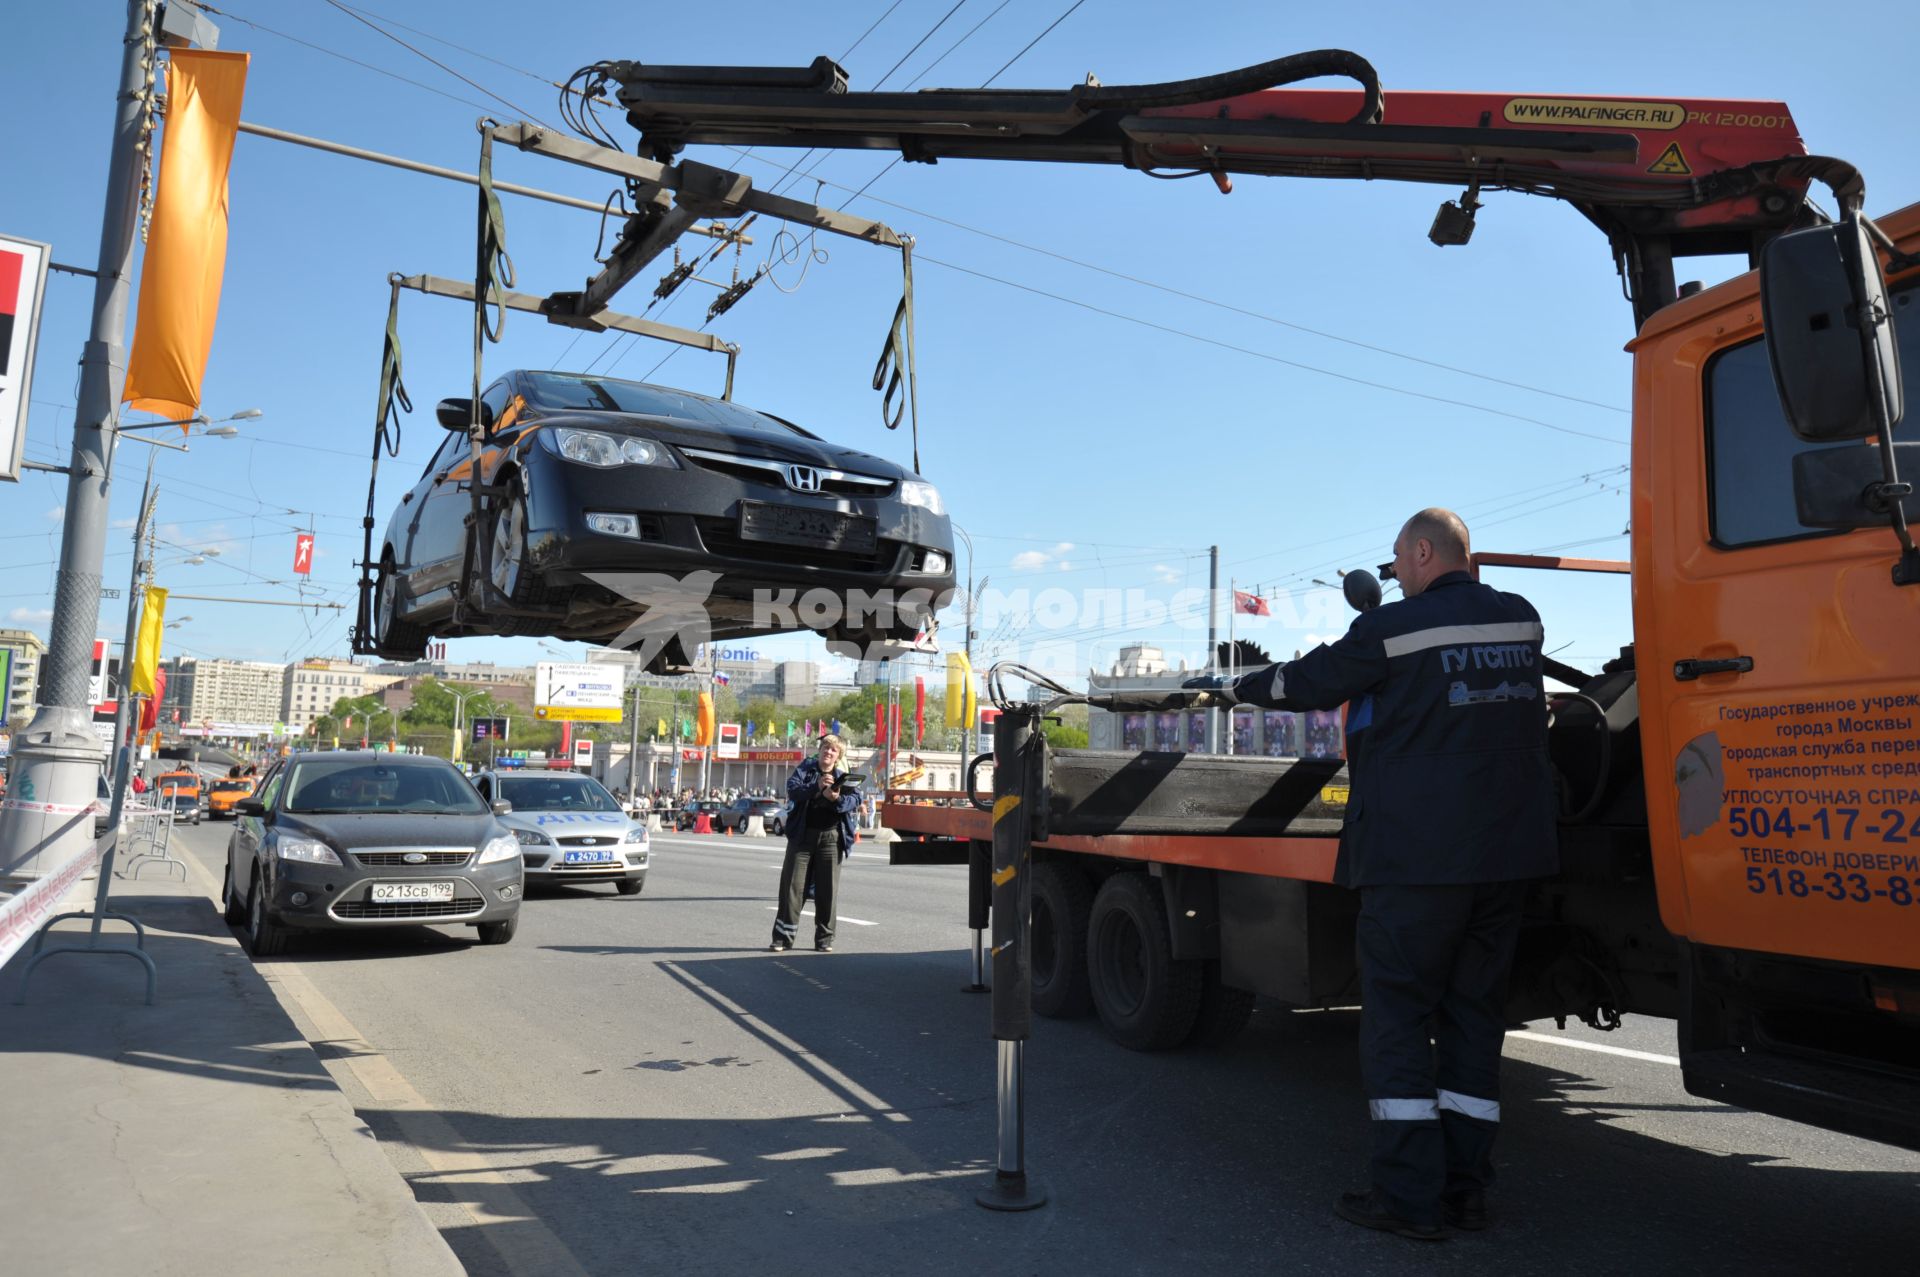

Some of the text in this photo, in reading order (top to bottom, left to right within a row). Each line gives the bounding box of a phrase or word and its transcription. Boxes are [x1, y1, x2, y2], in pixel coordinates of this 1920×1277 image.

[1513, 103, 1675, 123] WWW.PALFINGER.RU
[1687, 113, 1790, 129] PK 12000T
[1440, 647, 1468, 673] ГУ
[1719, 699, 1857, 722] Государственное
[1776, 717, 1912, 740] города Москвы
[1802, 741, 1866, 760] служба
[1871, 739, 1920, 757] пере
[1747, 761, 1920, 783] транспортных сред
[537, 814, 620, 826] ДПС
[1740, 847, 1828, 868] ТЕЛЕФОН
[432, 884, 451, 893] 199
[1746, 866, 1920, 907] 518-33-8
